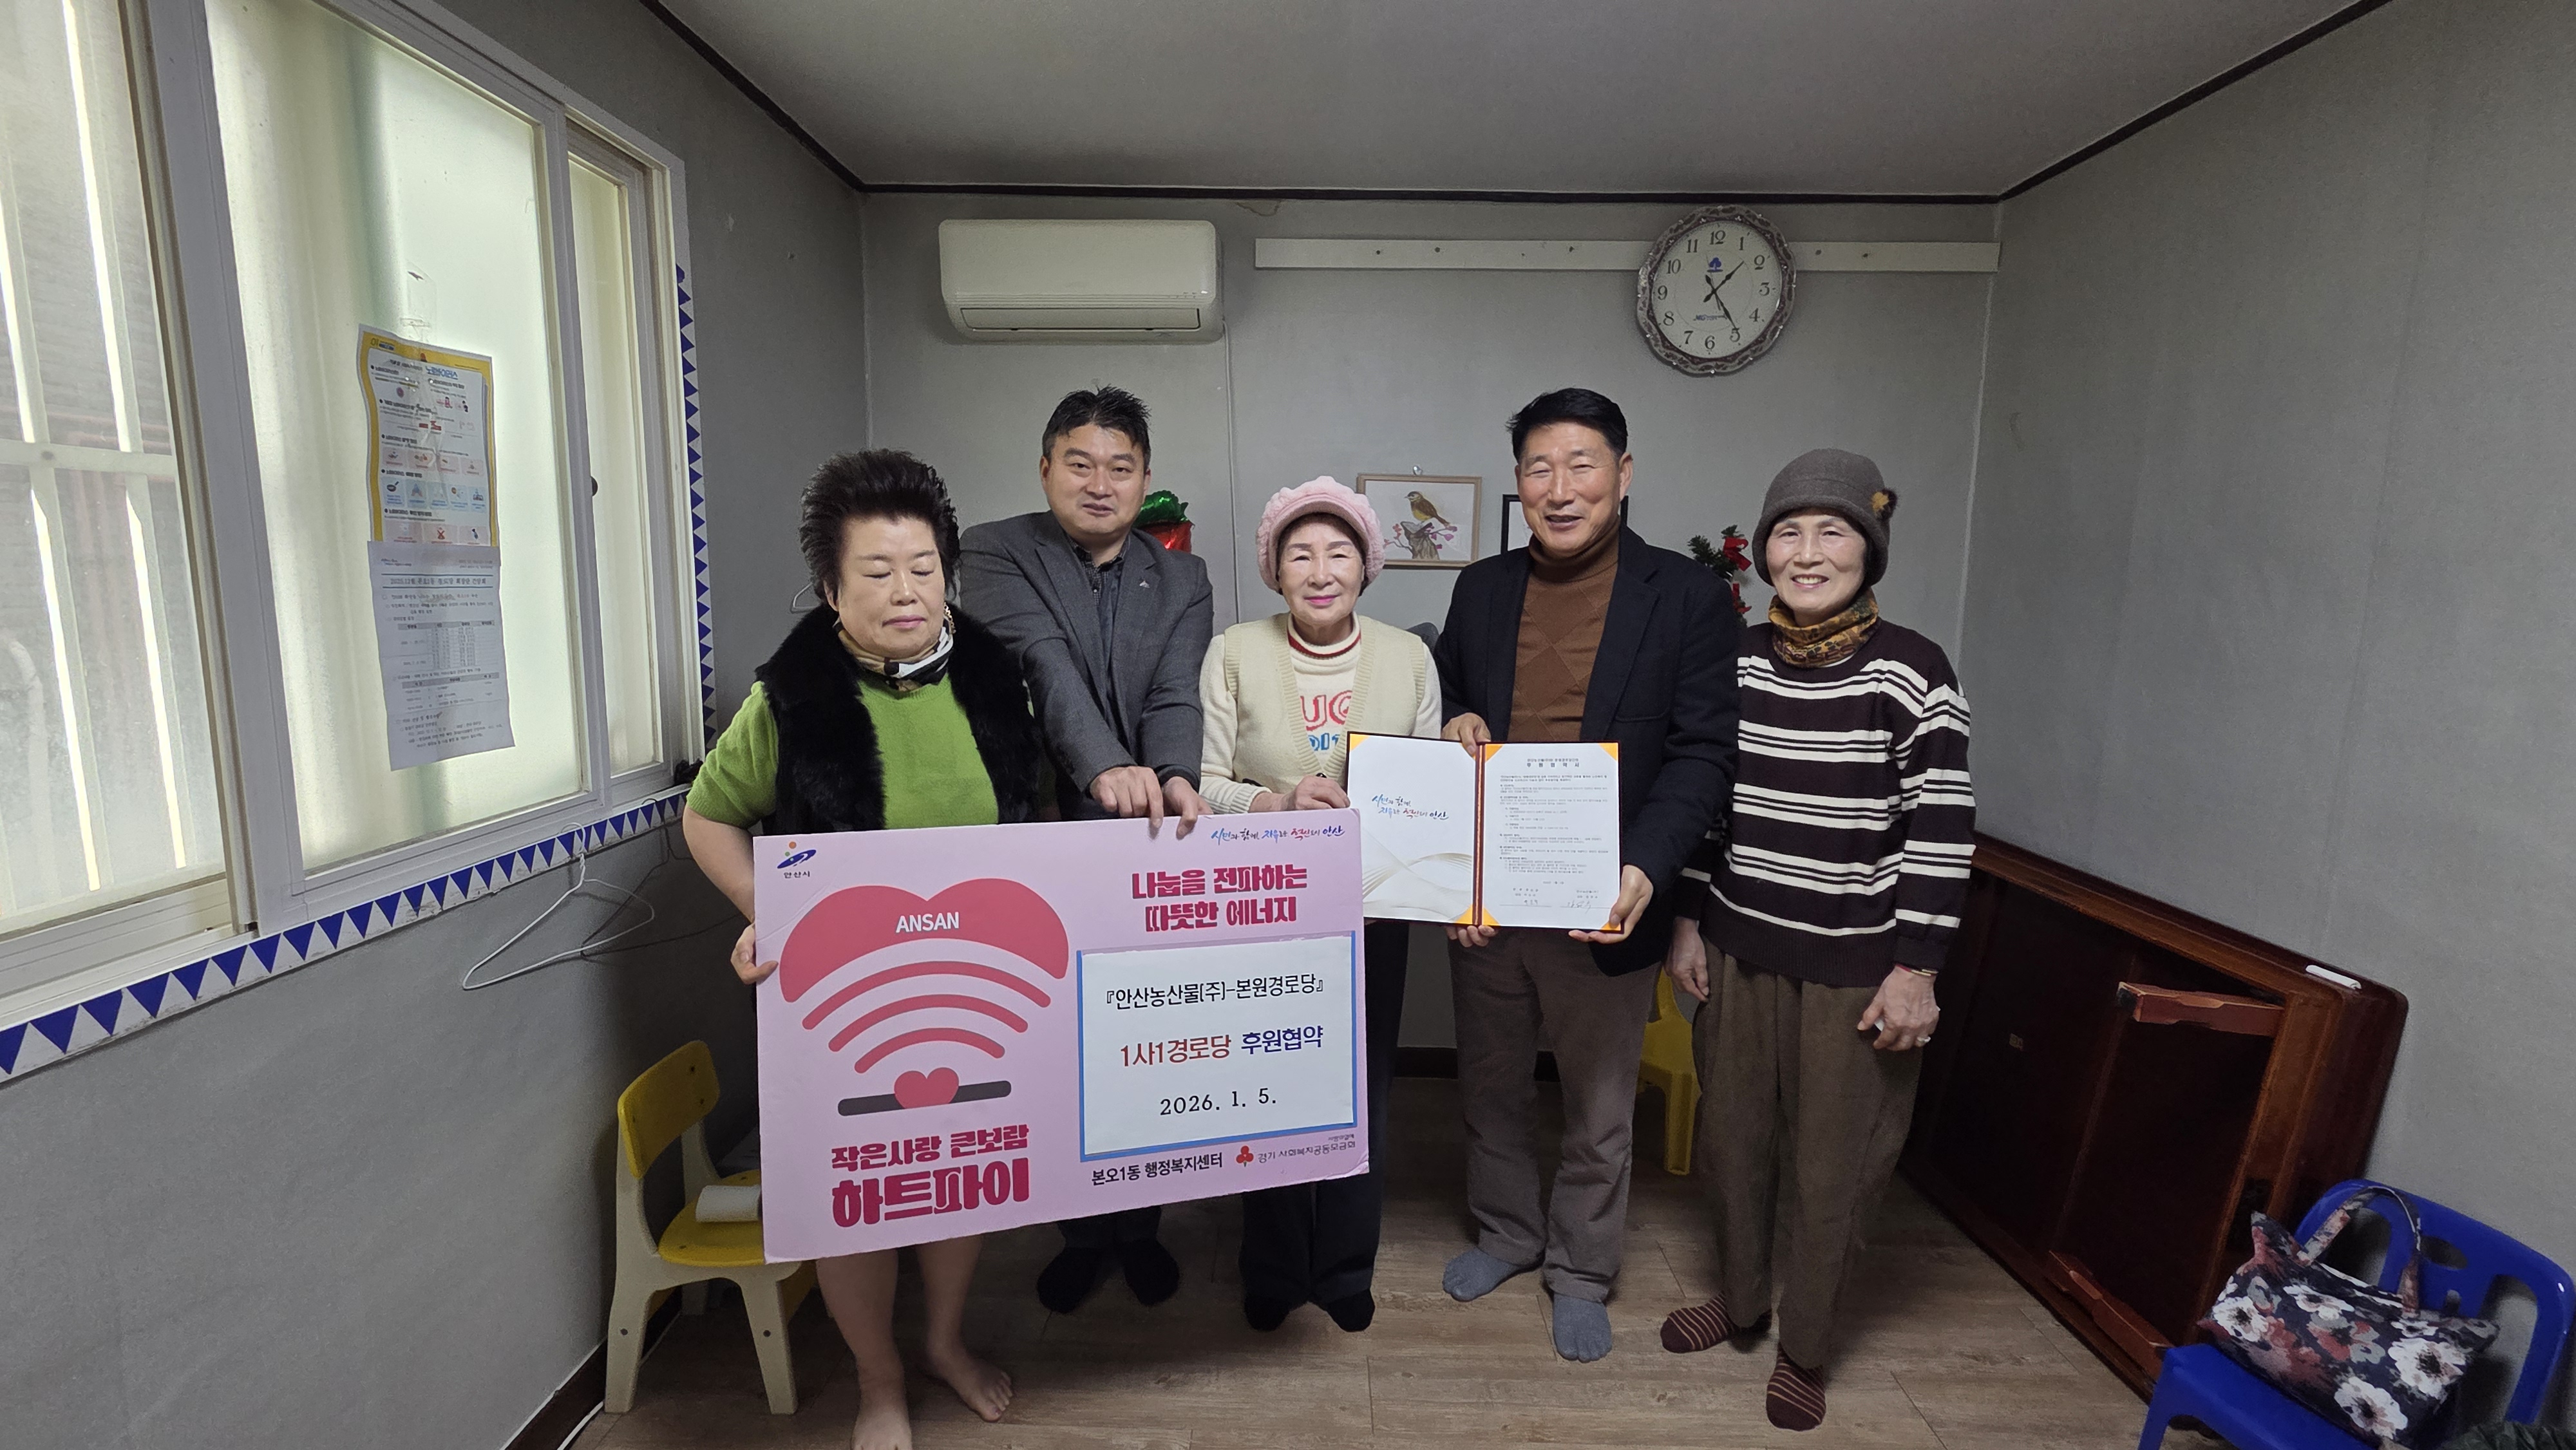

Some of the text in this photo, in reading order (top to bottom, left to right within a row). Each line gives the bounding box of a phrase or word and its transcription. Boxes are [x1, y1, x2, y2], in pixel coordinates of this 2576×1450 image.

[1710, 230, 1726, 245] 12
[1739, 236, 1745, 250] 1
[1687, 239, 1698, 253] 11
[1667, 259, 1681, 274] 10
[1754, 254, 1765, 270] 2
[1658, 285, 1667, 300] 9
[1759, 282, 1770, 296] 3
[1663, 311, 1674, 326] 8
[1749, 308, 1760, 322] 4
[1683, 330, 1693, 344] 7
[1705, 335, 1715, 350] 6
[1730, 328, 1740, 342] 5
[1430, 811, 1449, 820] 안산
[1211, 827, 1238, 845] 시민과
[1240, 828, 1260, 841] 함께
[1323, 825, 1345, 837] 안산
[784, 871, 810, 879] 안산시
[1132, 864, 1307, 899] 나눔을 전파하는
[1145, 896, 1296, 932] 따뜻한 에너지
[896, 912, 959, 933] ANSAN
[1121, 1025, 1323, 1067] 1사1경로당 후원협약
[1160, 1088, 1276, 1115] 2026. 1. 5.
[951, 1124, 1029, 1158] 큰보람
[1258, 1141, 1356, 1163] 경기 사회복지공동모금회
[1092, 1153, 1223, 1186] 본오1동 행정복지센터
[832, 1158, 1029, 1227] 하트파이
